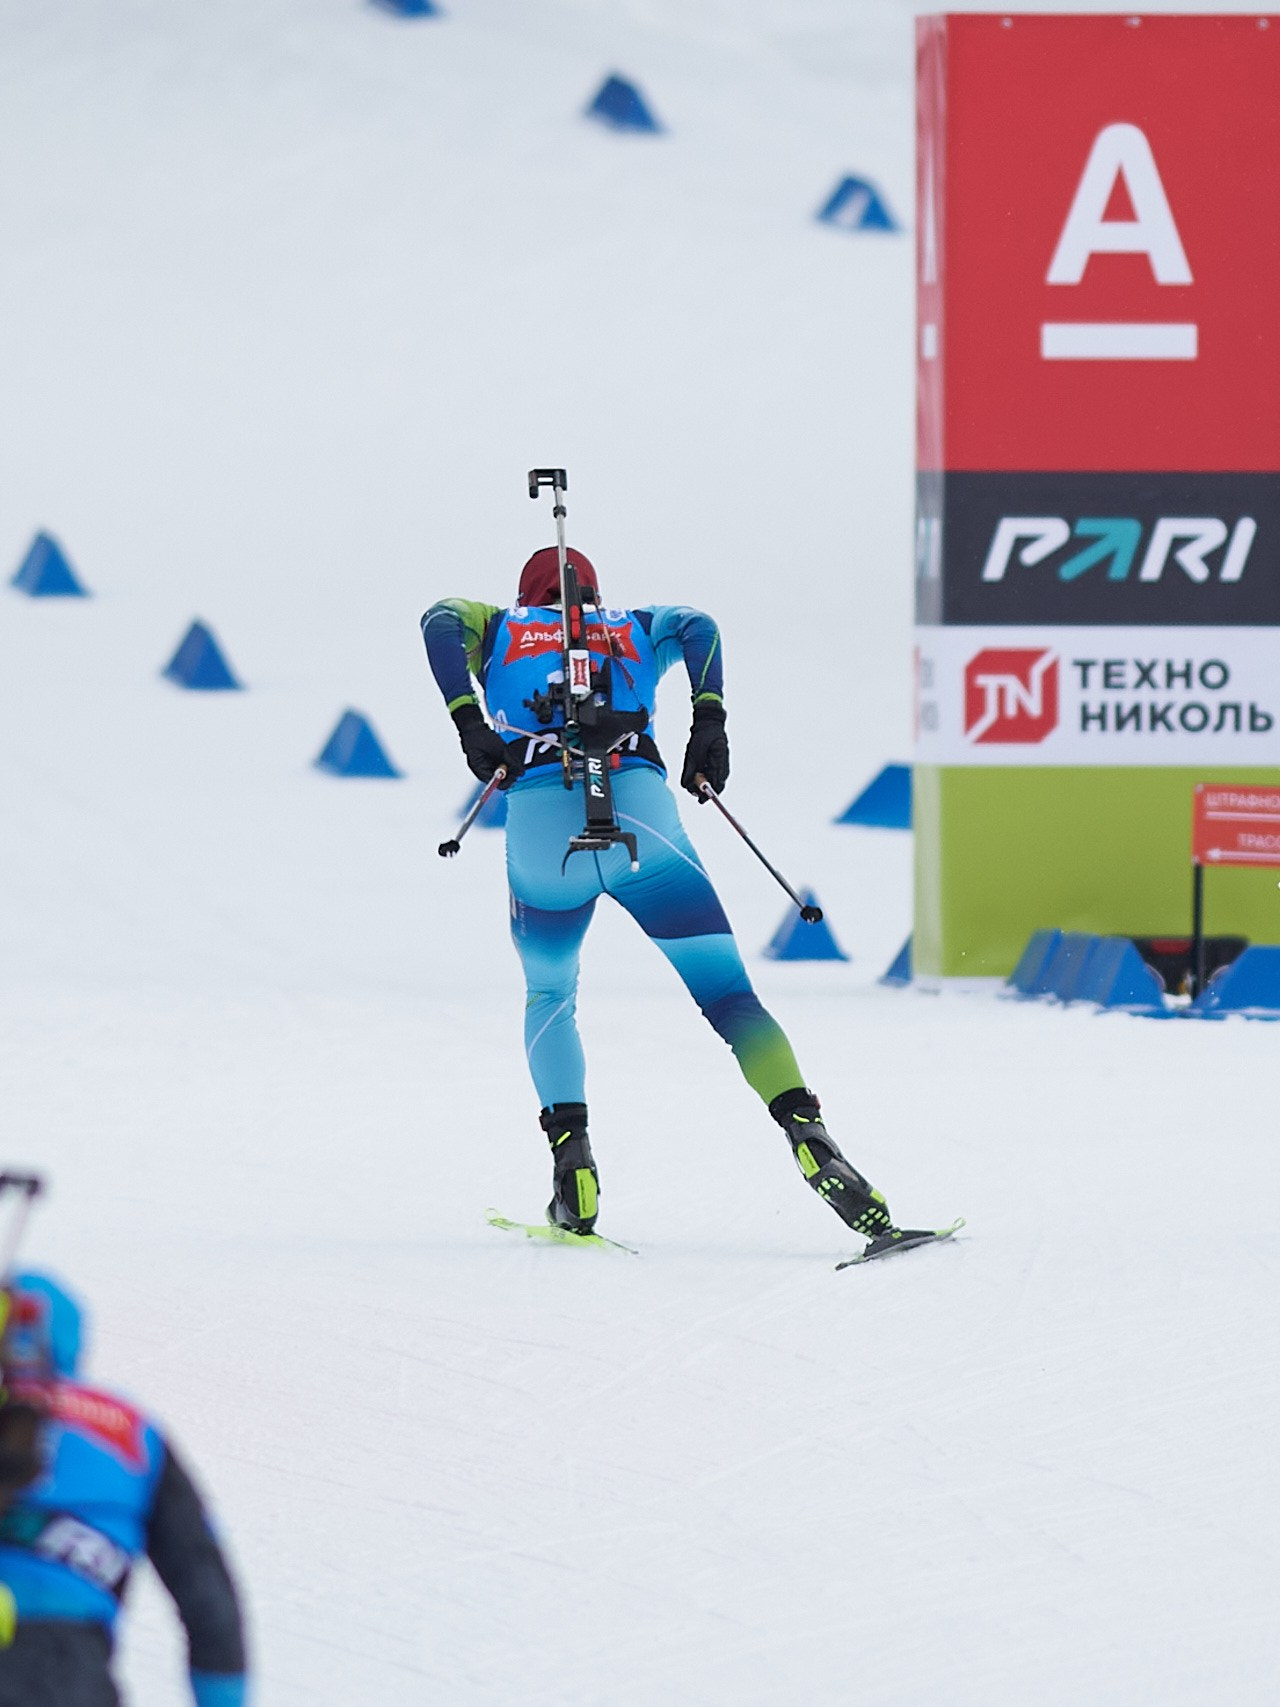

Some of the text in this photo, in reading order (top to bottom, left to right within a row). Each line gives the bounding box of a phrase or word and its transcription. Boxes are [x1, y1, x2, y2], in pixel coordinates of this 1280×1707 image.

[981, 516, 1258, 583] PARI
[521, 628, 565, 645] Альф
[1072, 658, 1231, 690] ТЕХНО
[1080, 703, 1275, 734] НИКОЛЬ
[523, 732, 639, 765] PI
[588, 757, 605, 798] PARI
